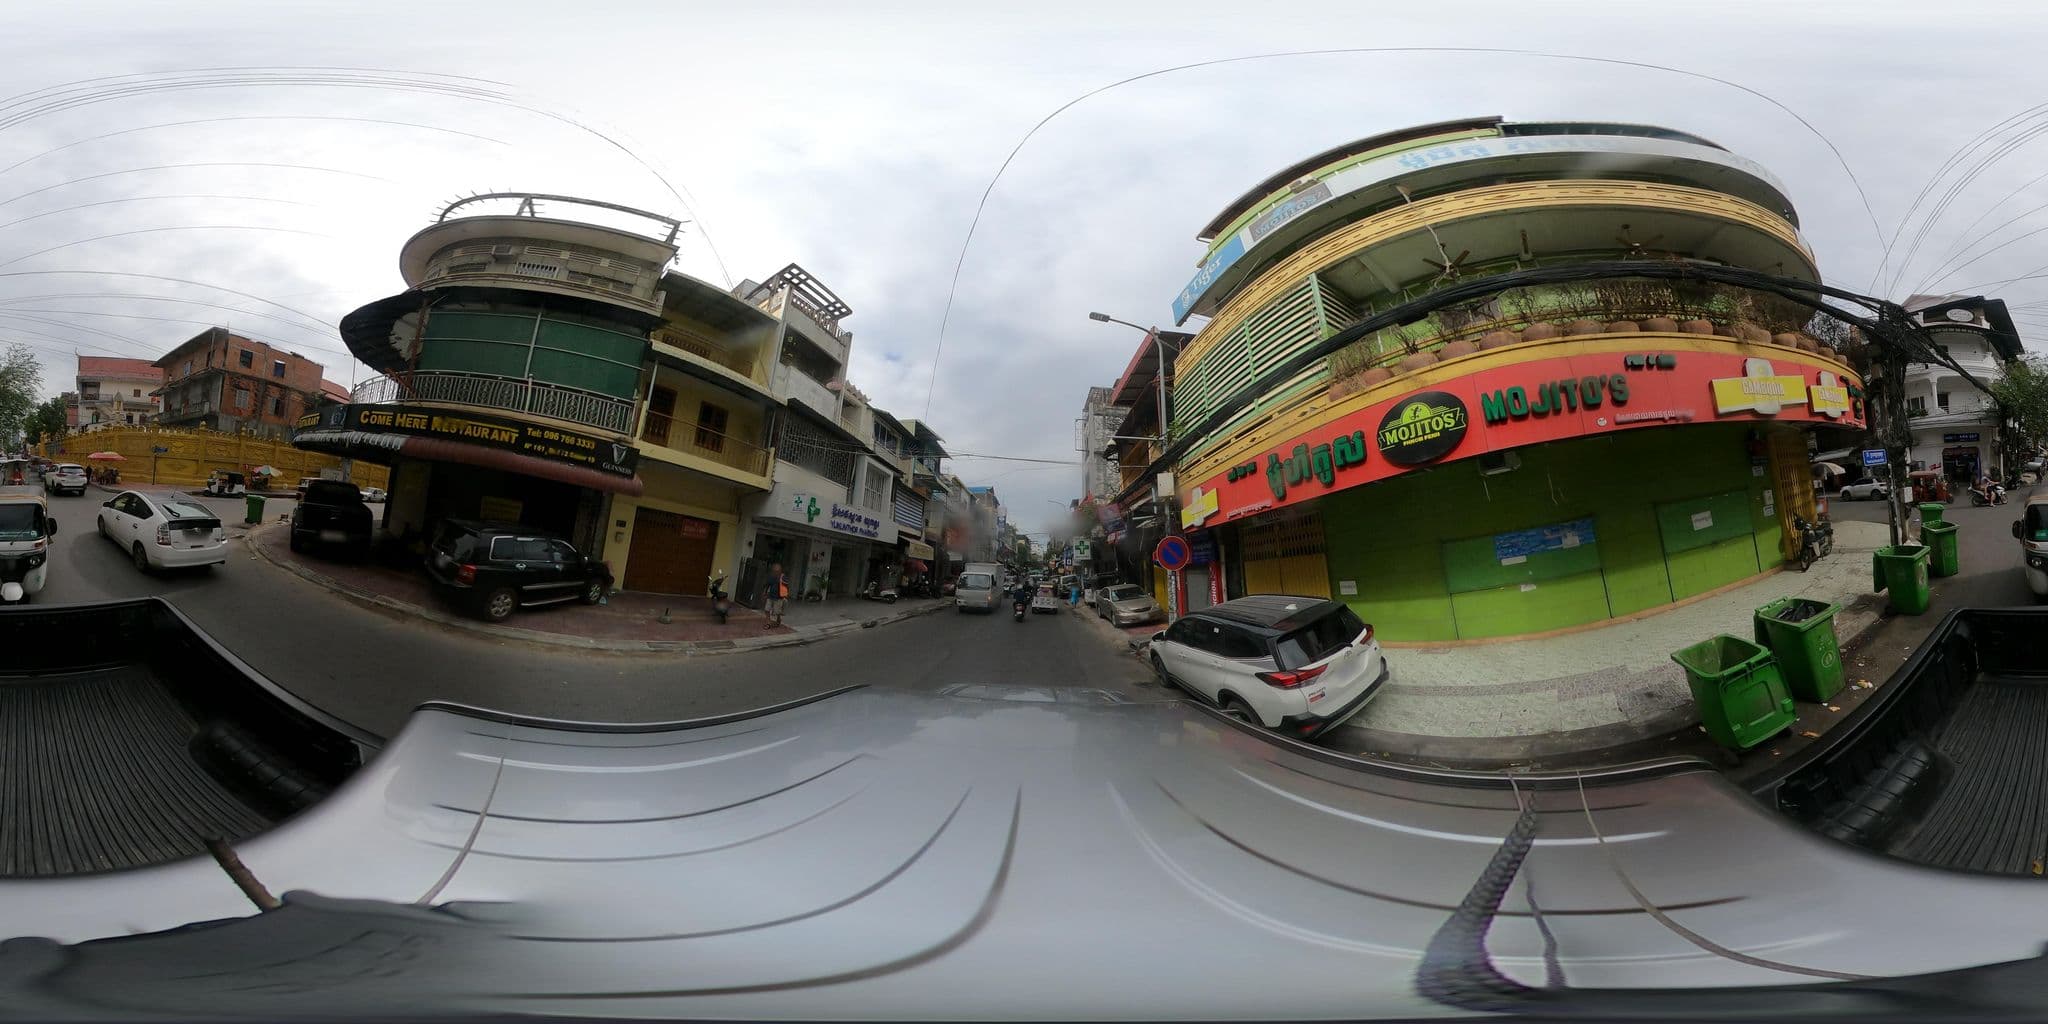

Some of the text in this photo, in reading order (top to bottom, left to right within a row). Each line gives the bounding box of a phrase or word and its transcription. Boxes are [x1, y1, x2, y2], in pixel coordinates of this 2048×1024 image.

[1191, 255, 1222, 289] Tiger
[1481, 374, 1629, 422] MOJITO'S
[360, 410, 393, 426] COME
[395, 413, 428, 430] HERE
[1385, 412, 1456, 446] MOJITO'S
